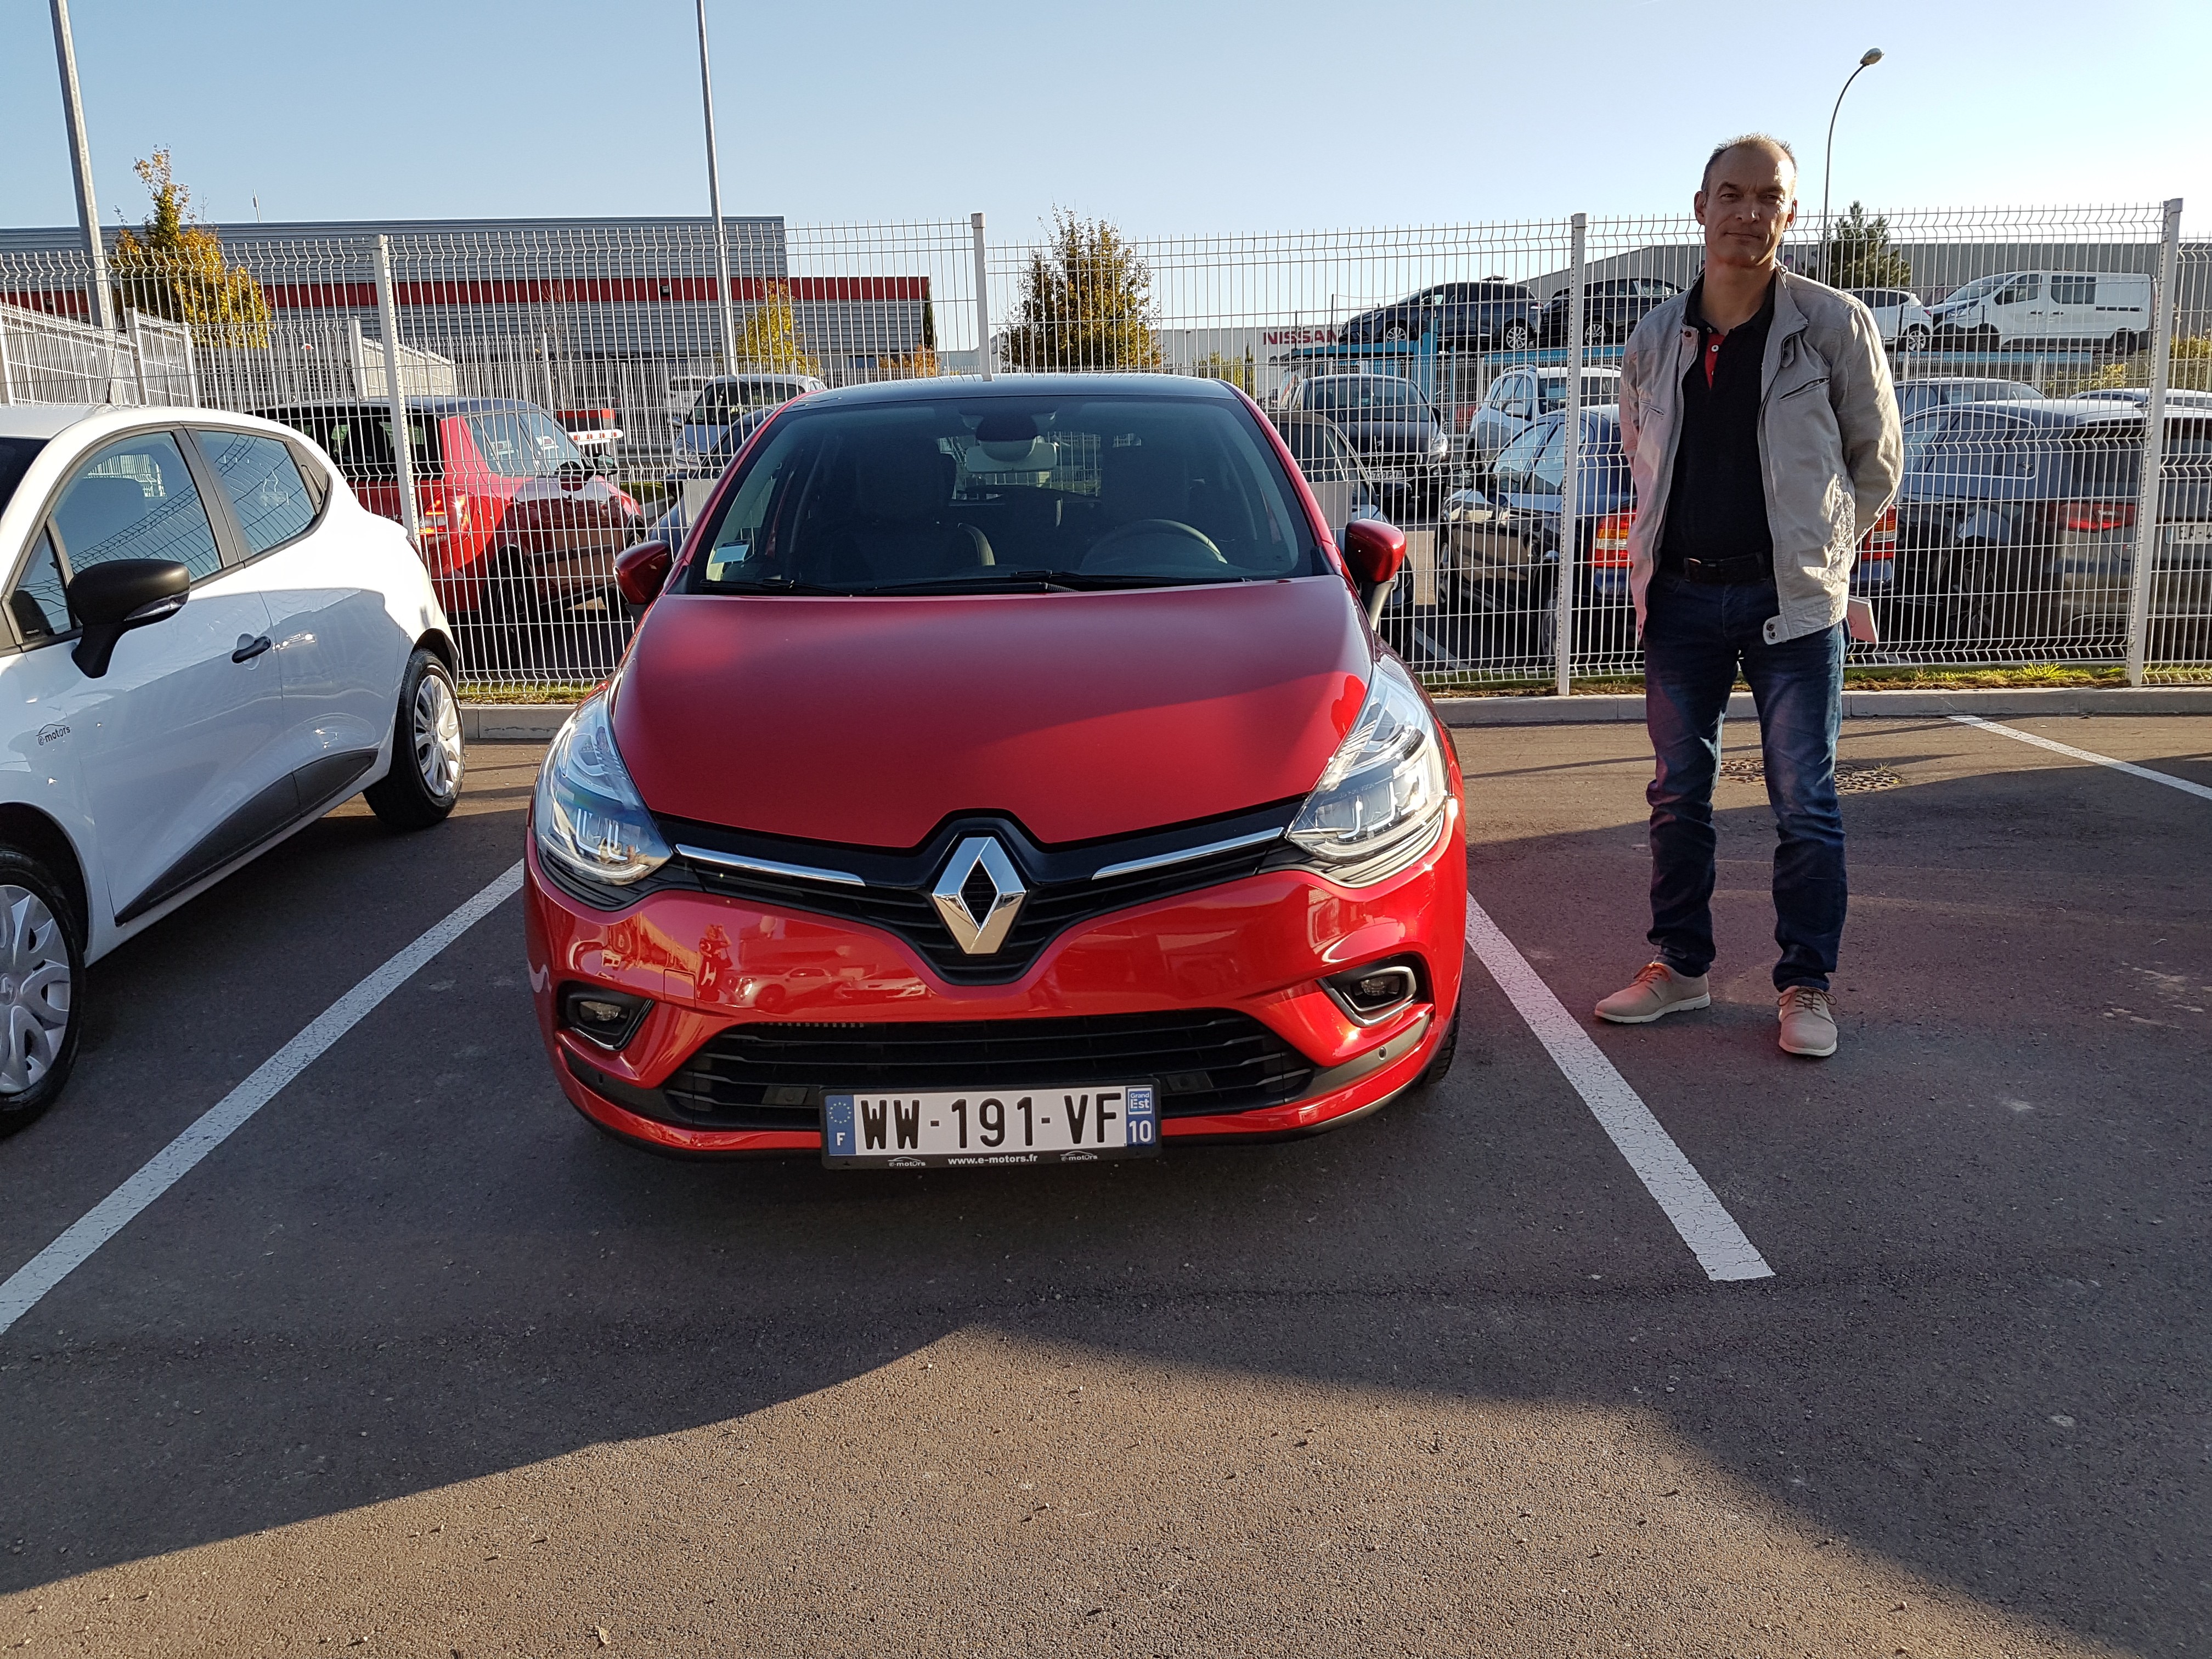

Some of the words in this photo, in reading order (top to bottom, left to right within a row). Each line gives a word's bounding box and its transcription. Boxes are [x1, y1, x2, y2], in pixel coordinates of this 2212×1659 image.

[1263, 330, 1340, 345] NISSAN
[1130, 1098, 1150, 1109] Est
[861, 1092, 1122, 1150] WW-191-VF
[1129, 1120, 1152, 1143] 10
[837, 1132, 845, 1146] F
[947, 1154, 1038, 1165] www.e-motors.fr
